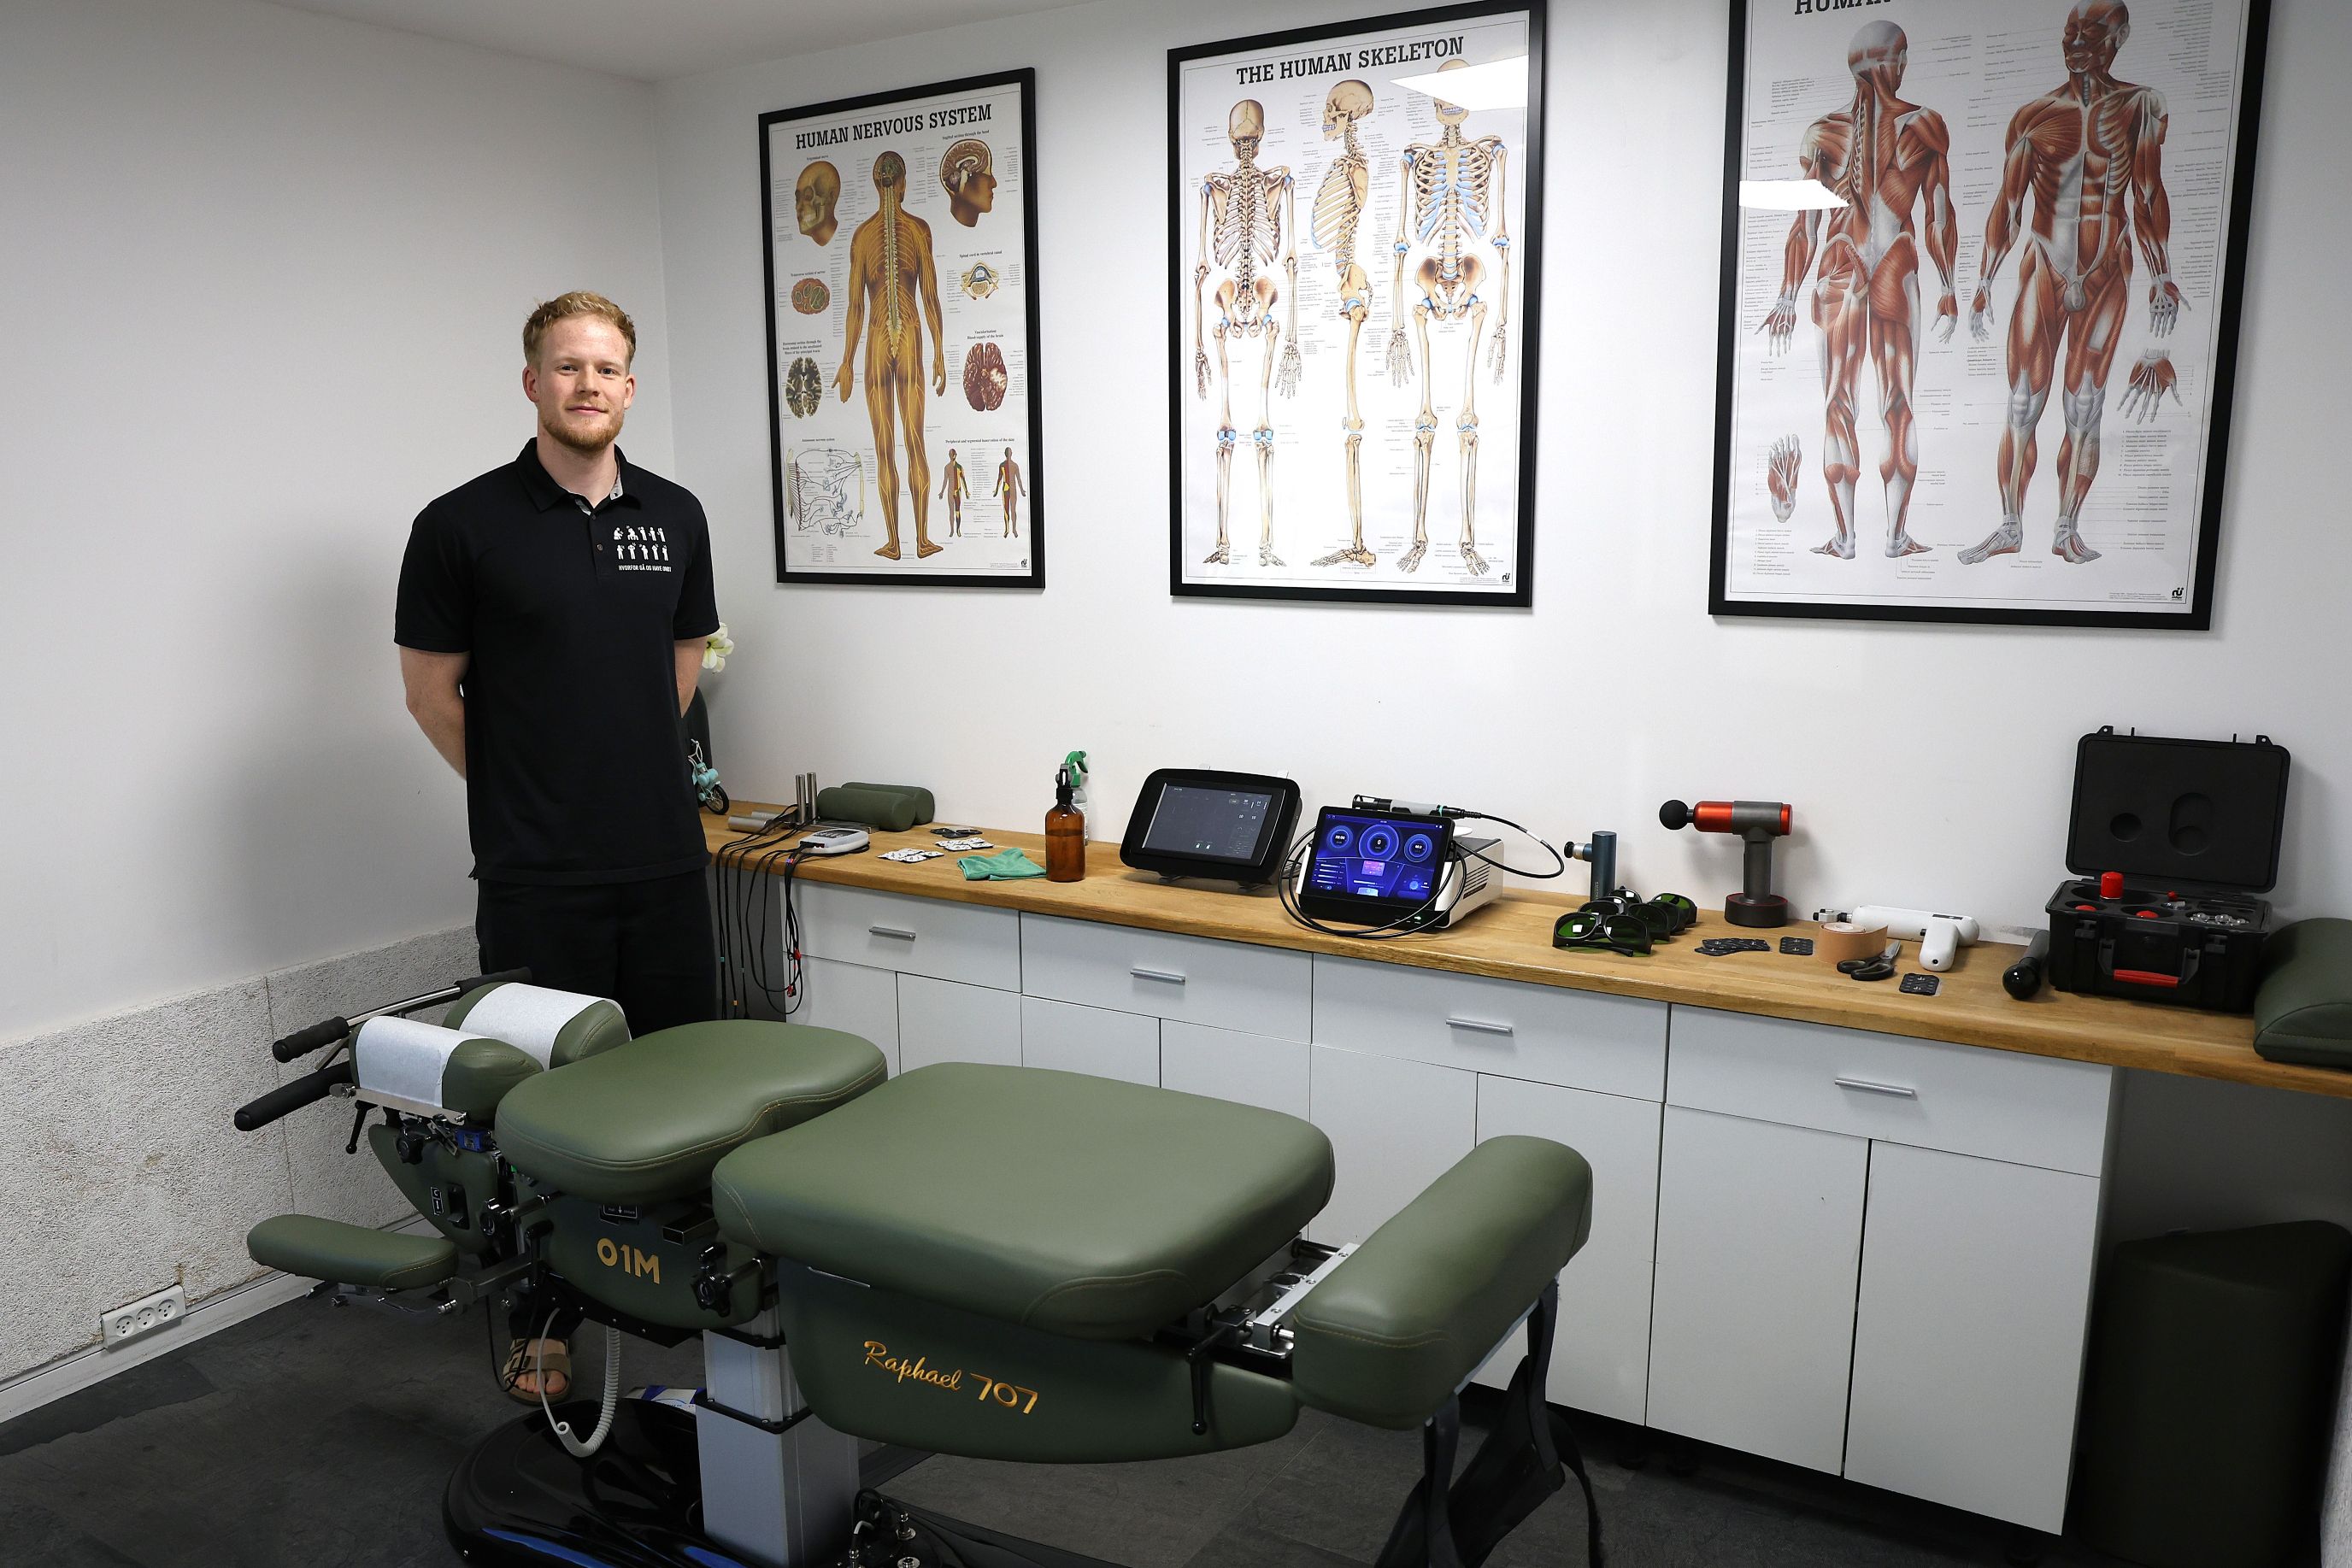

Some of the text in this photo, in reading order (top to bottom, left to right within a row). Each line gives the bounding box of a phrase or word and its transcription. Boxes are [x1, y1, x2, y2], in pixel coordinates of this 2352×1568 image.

[1237, 37, 1464, 85] THE HUMAN SKELETON
[796, 103, 991, 150] HUMAN NERVOUS SYSTEM
[864, 1341, 1038, 1414] Raphael 707
